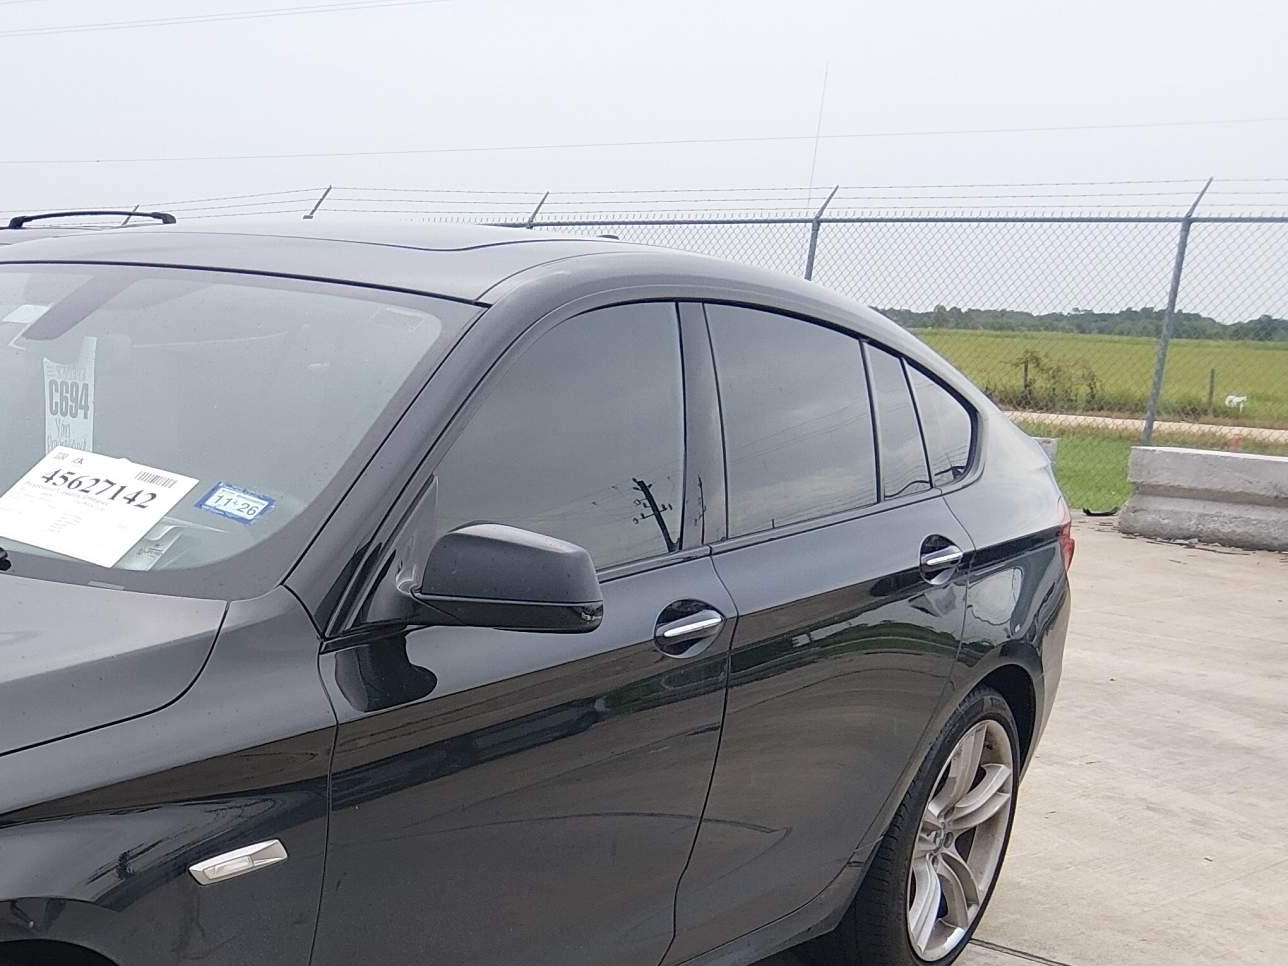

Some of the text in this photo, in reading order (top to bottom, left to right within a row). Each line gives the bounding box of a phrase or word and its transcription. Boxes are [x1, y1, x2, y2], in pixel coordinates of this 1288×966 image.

[49, 379, 89, 419] C694
[41, 469, 158, 509] 45627142
[214, 495, 233, 507] 11
[237, 502, 260, 516] 26
